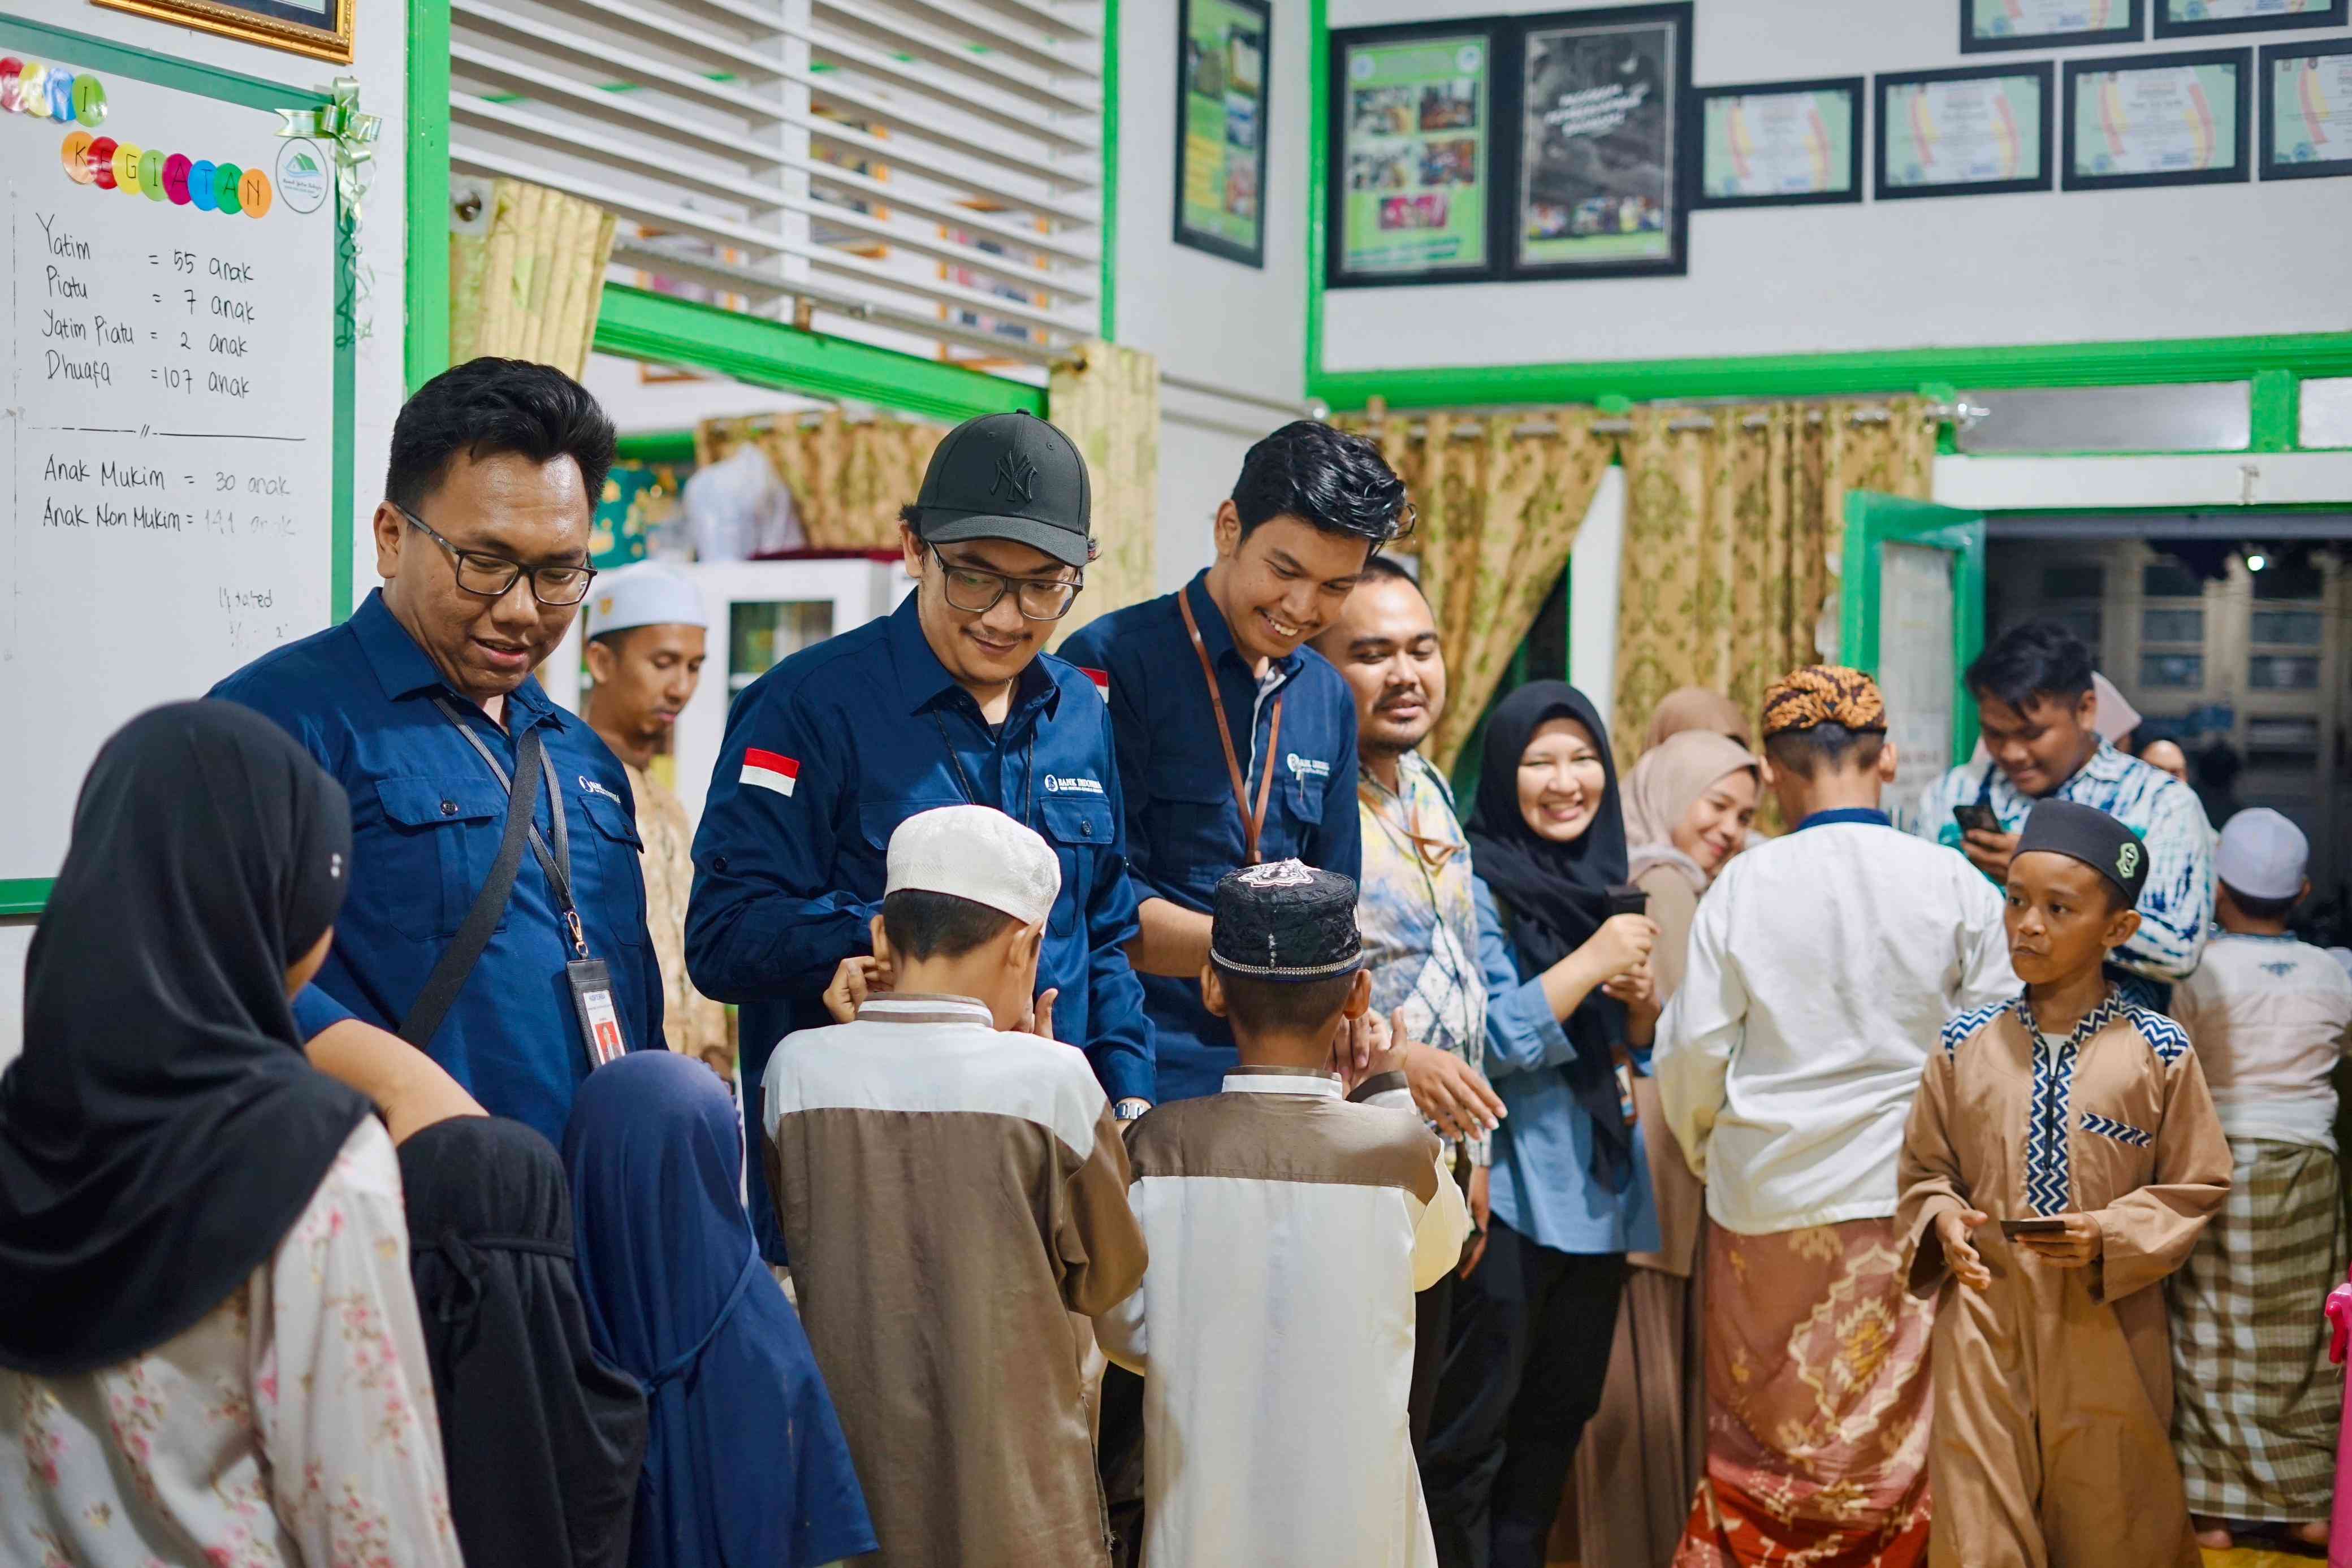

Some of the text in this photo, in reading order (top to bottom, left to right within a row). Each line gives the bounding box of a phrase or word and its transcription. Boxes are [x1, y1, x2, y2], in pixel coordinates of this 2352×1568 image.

[75, 140, 261, 207] KEGIATAN
[36, 212, 91, 261] Yatim
[173, 249, 197, 274] 55
[209, 257, 254, 283] anak
[46, 264, 88, 300] Piatu
[184, 289, 197, 315] 7
[211, 295, 256, 323] anak
[94, 315, 135, 346] Piatu
[180, 331, 192, 350] 2
[209, 333, 249, 358] anak
[45, 349, 112, 389] Dhuafa
[164, 366, 193, 395] 107
[208, 371, 250, 399] anak
[44, 453, 91, 482] Anak
[101, 460, 165, 490] Mukim
[215, 471, 236, 492] 30
[43, 496, 89, 527] Anak
[96, 502, 128, 528] Non
[133, 505, 181, 532] Mukim
[1057, 778, 1077, 787] BANK
